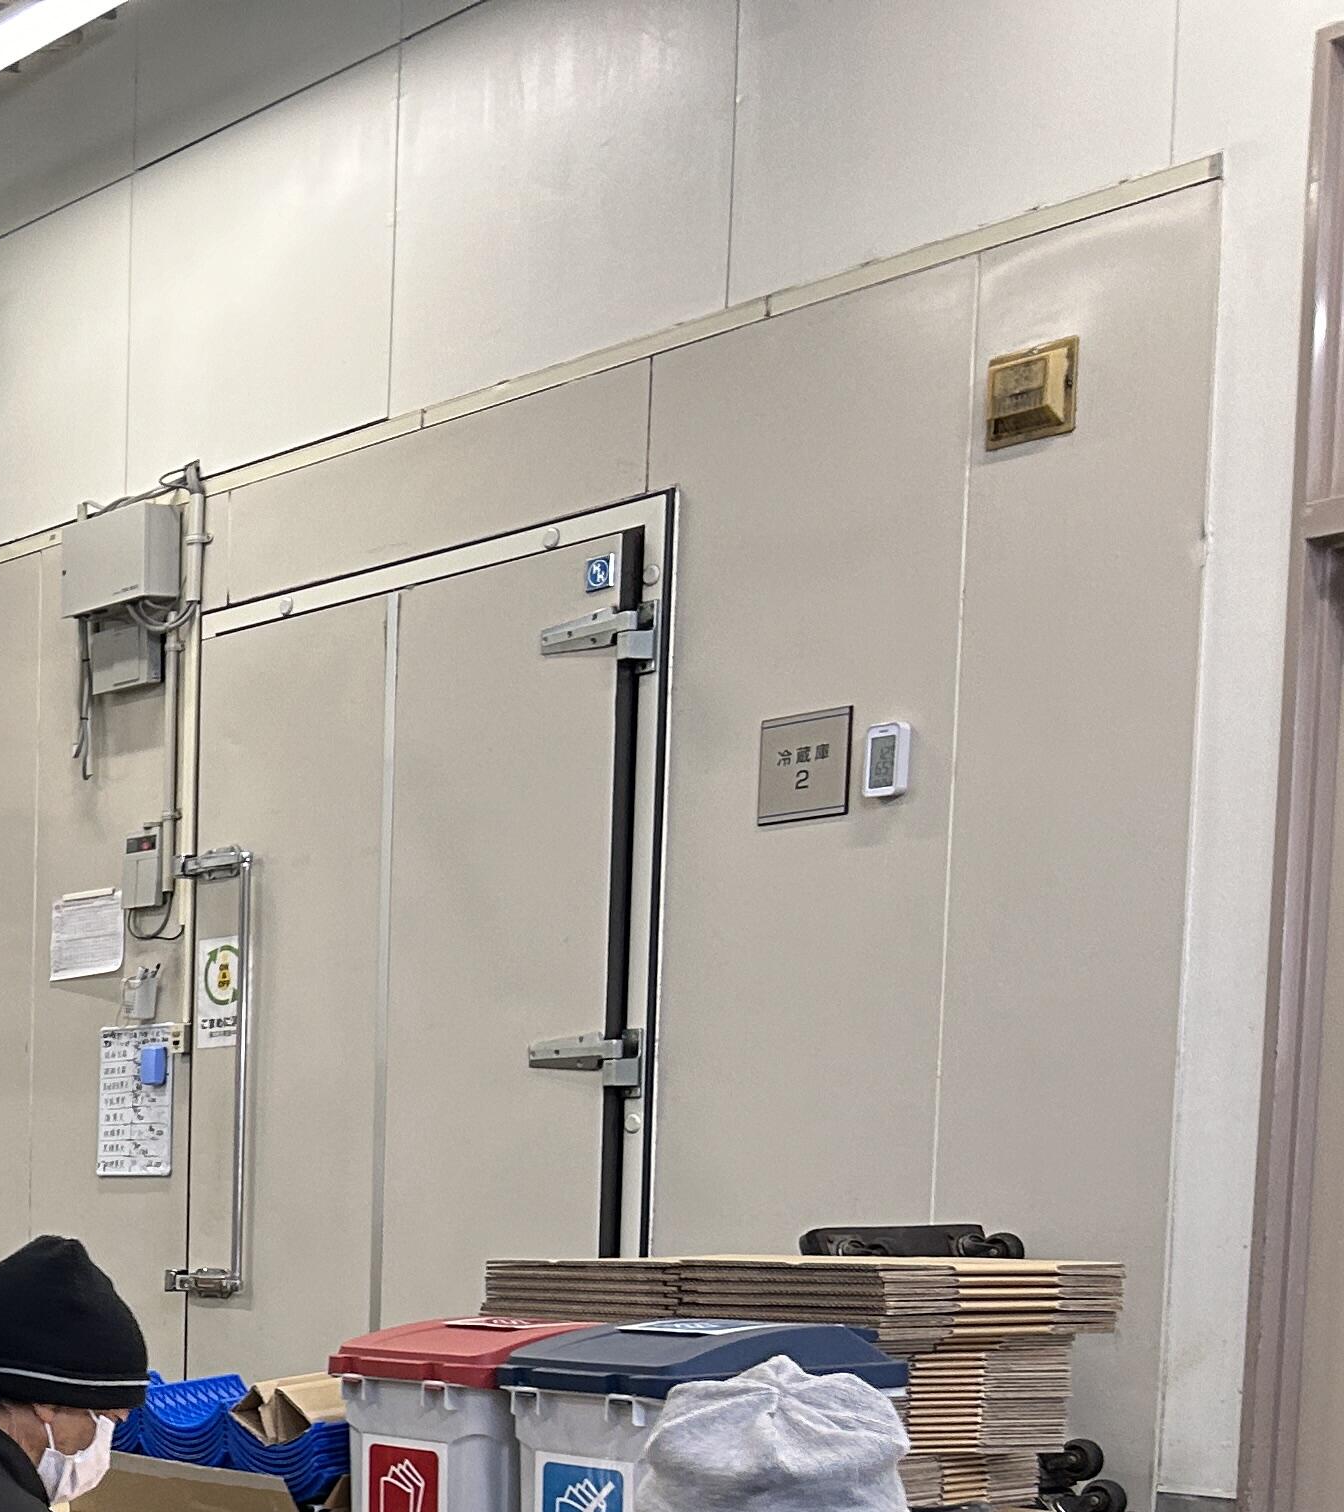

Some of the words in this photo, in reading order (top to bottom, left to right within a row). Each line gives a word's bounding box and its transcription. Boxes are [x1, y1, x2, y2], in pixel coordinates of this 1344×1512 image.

[777, 743, 830, 767] 冷蔵庫
[795, 769, 809, 790] 2
